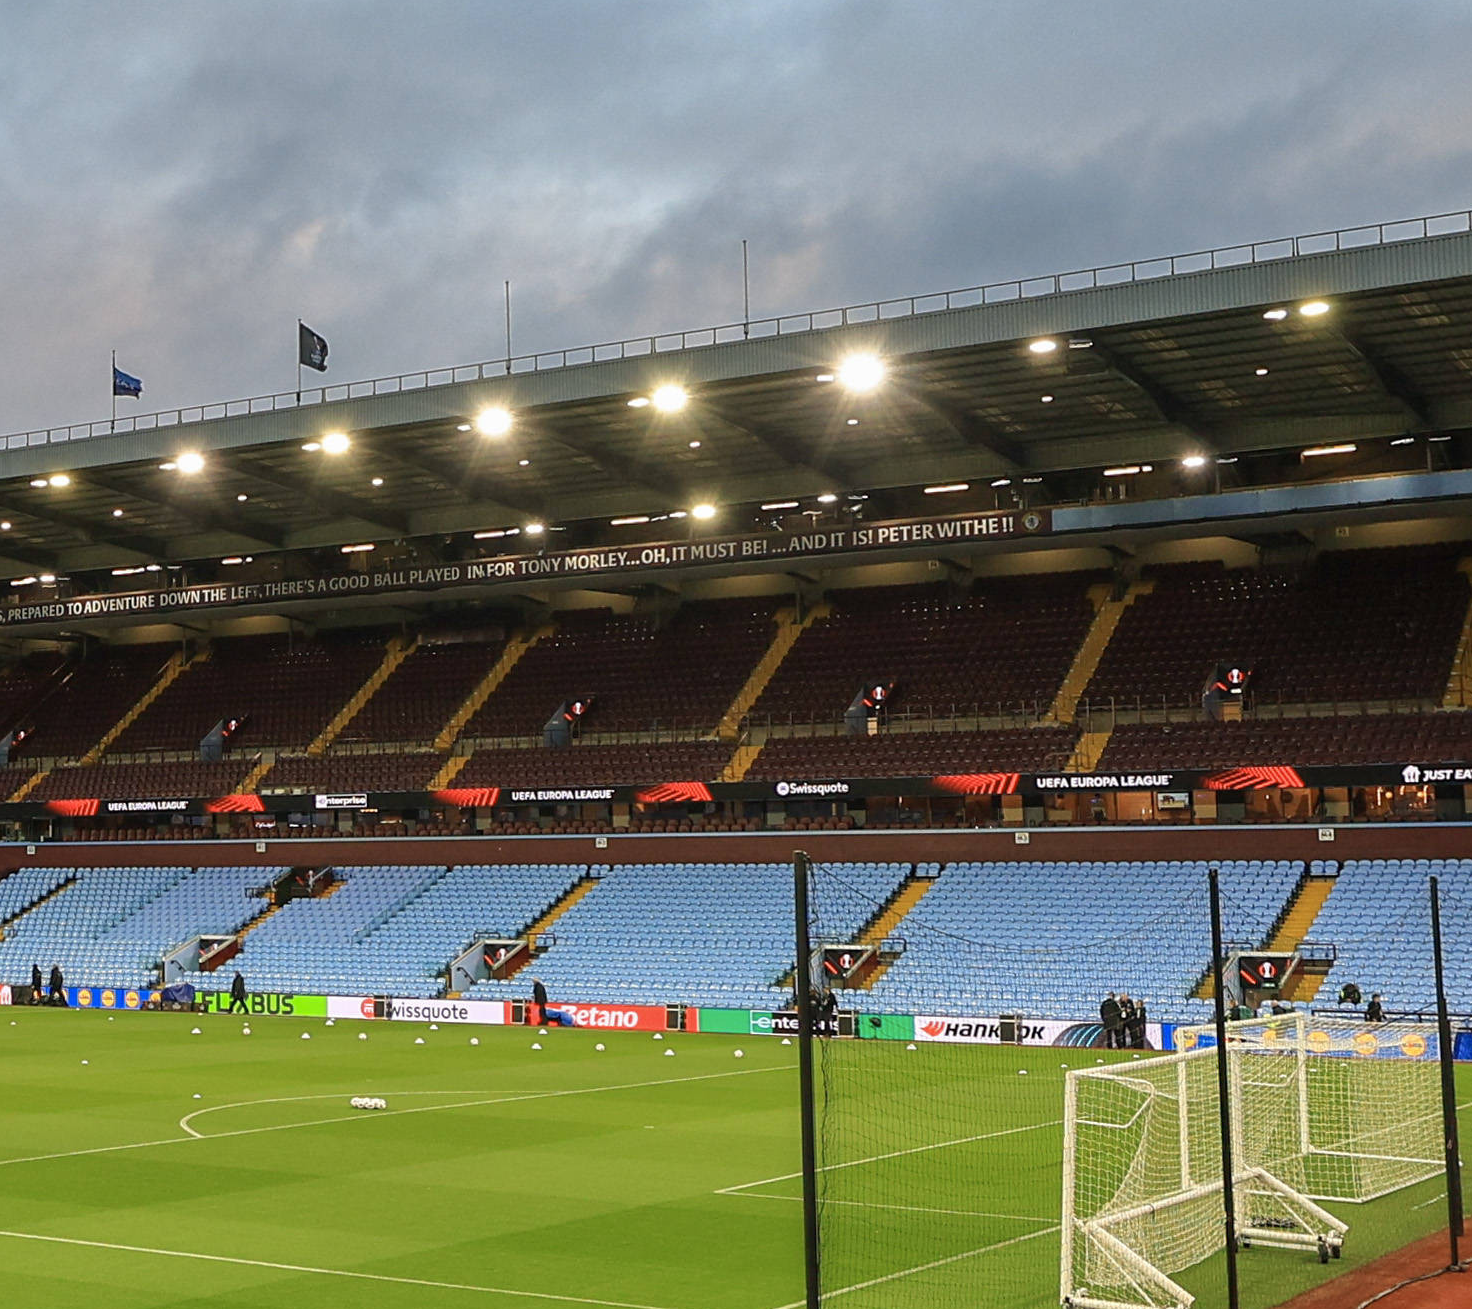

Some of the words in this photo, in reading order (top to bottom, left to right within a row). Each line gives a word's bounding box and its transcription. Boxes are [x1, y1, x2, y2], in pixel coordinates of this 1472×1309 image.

[7, 603, 64, 622] PREPARED
[67, 601, 82, 615] TO
[84, 594, 155, 614] ADVENTURE
[160, 591, 200, 607] DOWN
[203, 587, 226, 603] THE
[231, 584, 263, 601] LEFT,
[264, 578, 314, 597] THERE'S
[317, 578, 326, 592] A
[329, 574, 369, 590] GOOD
[374, 571, 406, 587] BALL
[410, 566, 460, 584] PLAYED
[467, 564, 485, 580] IN
[487, 561, 515, 578] FOR
[519, 557, 562, 574] TONY
[672, 546, 687, 561] IT
[691, 542, 737, 560] MUST
[742, 539, 767, 556] BE!
[831, 532, 845, 548] IT
[853, 529, 873, 546] IS!
[878, 525, 934, 544] PETER
[939, 517, 999, 539] WITHE
[1037, 777, 1069, 788] UEFA
[1070, 776, 1119, 788] EUROPA
[1120, 775, 1170, 786] LEAGUE
[1423, 769, 1453, 782] JUST
[512, 792, 536, 801] UEFA
[538, 791, 573, 801] EUROPA
[575, 790, 612, 800] LEAGUE
[790, 782, 849, 796] Swissquote
[108, 802, 127, 811] UEFA
[128, 802, 157, 811] EUROPA
[391, 1000, 468, 1022] wissquote
